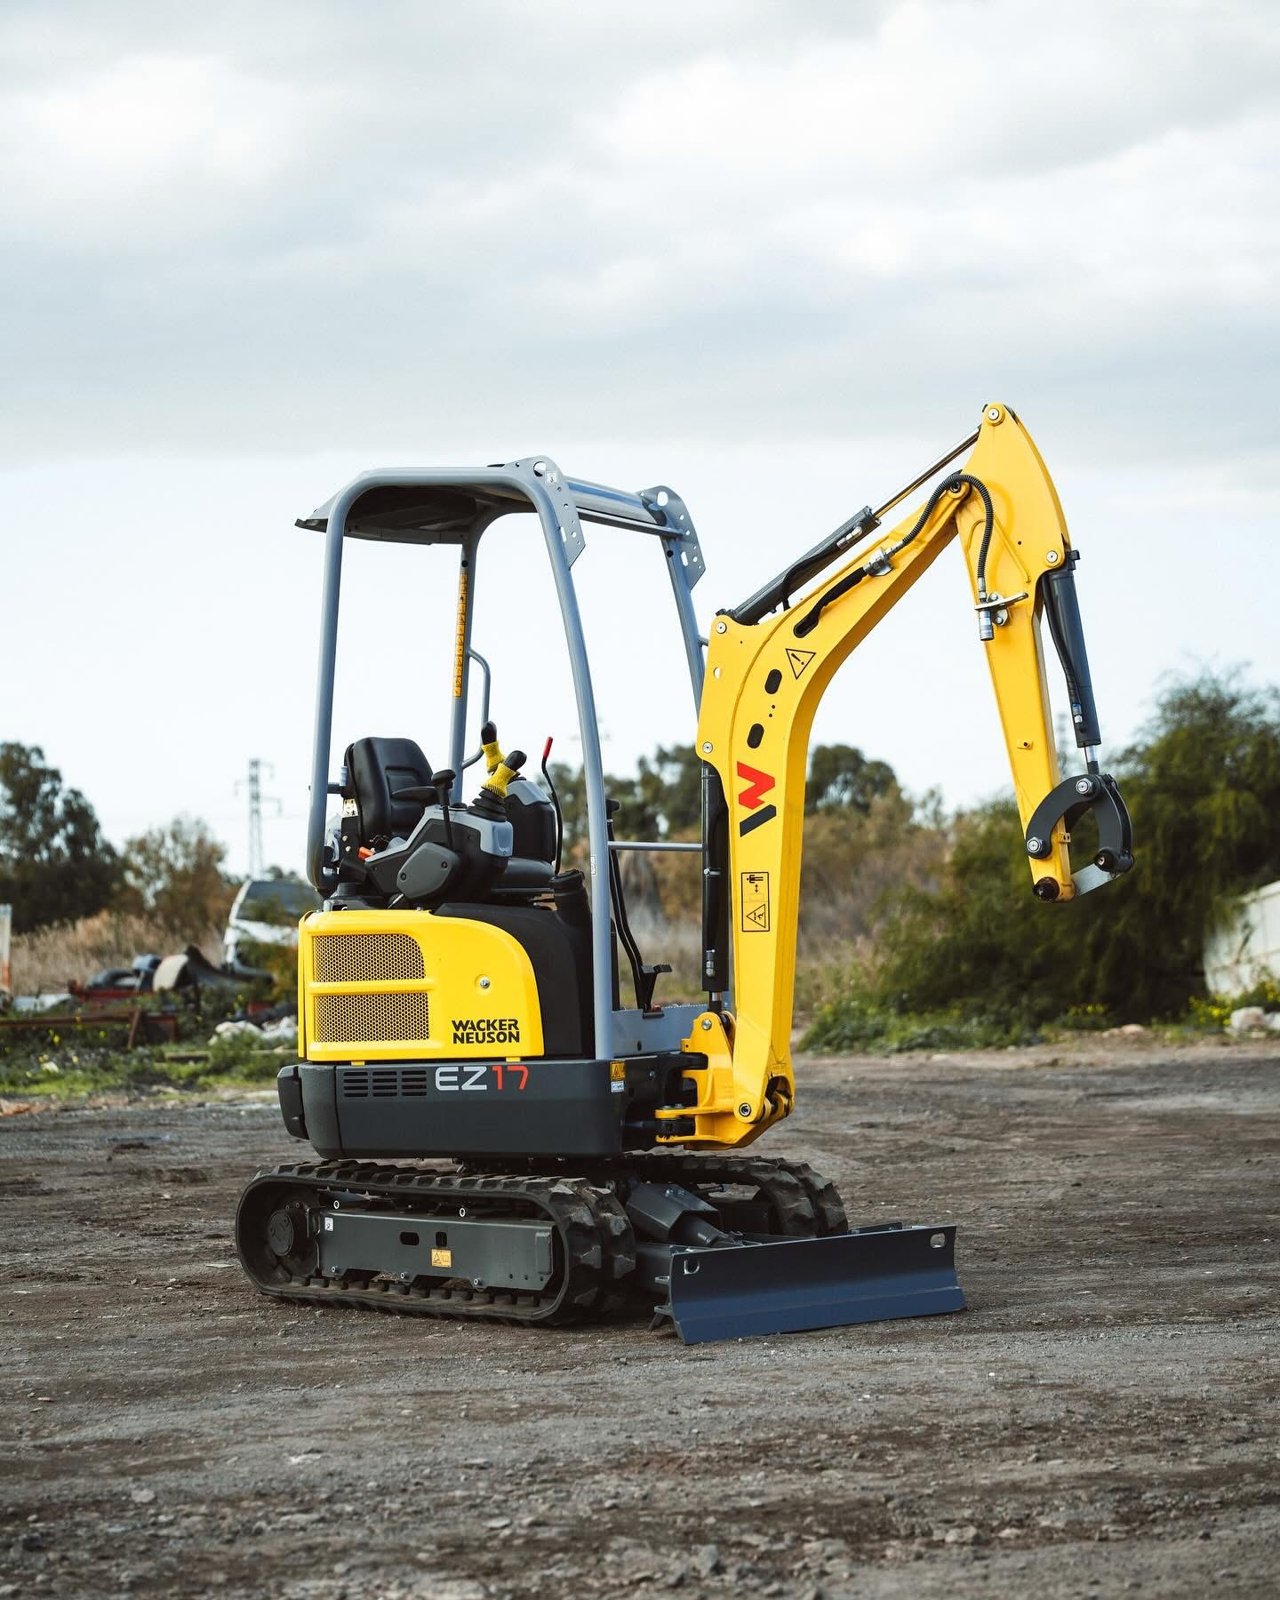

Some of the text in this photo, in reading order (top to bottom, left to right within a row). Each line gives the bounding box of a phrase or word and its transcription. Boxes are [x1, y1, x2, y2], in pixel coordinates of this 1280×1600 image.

[451, 1018, 520, 1032] WACKER
[452, 1031, 520, 1044] NEUSON
[435, 1065, 529, 1091] EZ17
